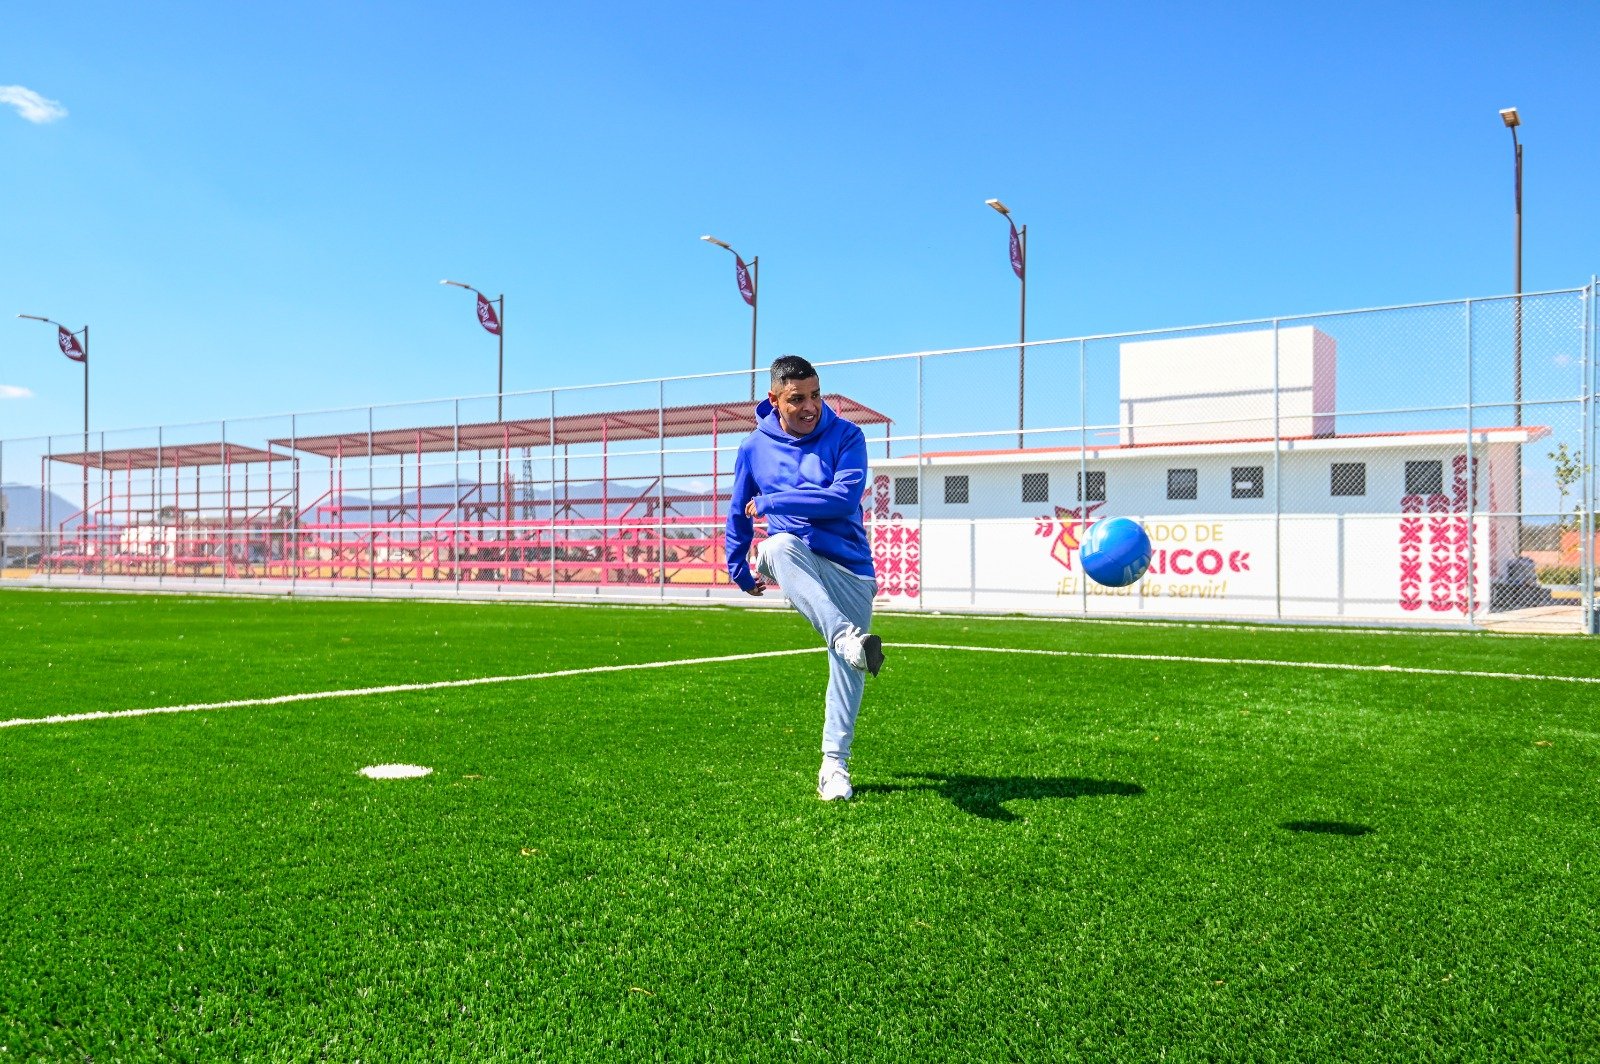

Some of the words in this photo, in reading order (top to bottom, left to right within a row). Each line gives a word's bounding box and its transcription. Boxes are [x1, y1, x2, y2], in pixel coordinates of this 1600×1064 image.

[1195, 524, 1223, 542] DE
[1140, 579, 1161, 597] de
[1168, 580, 1227, 599] servir!
